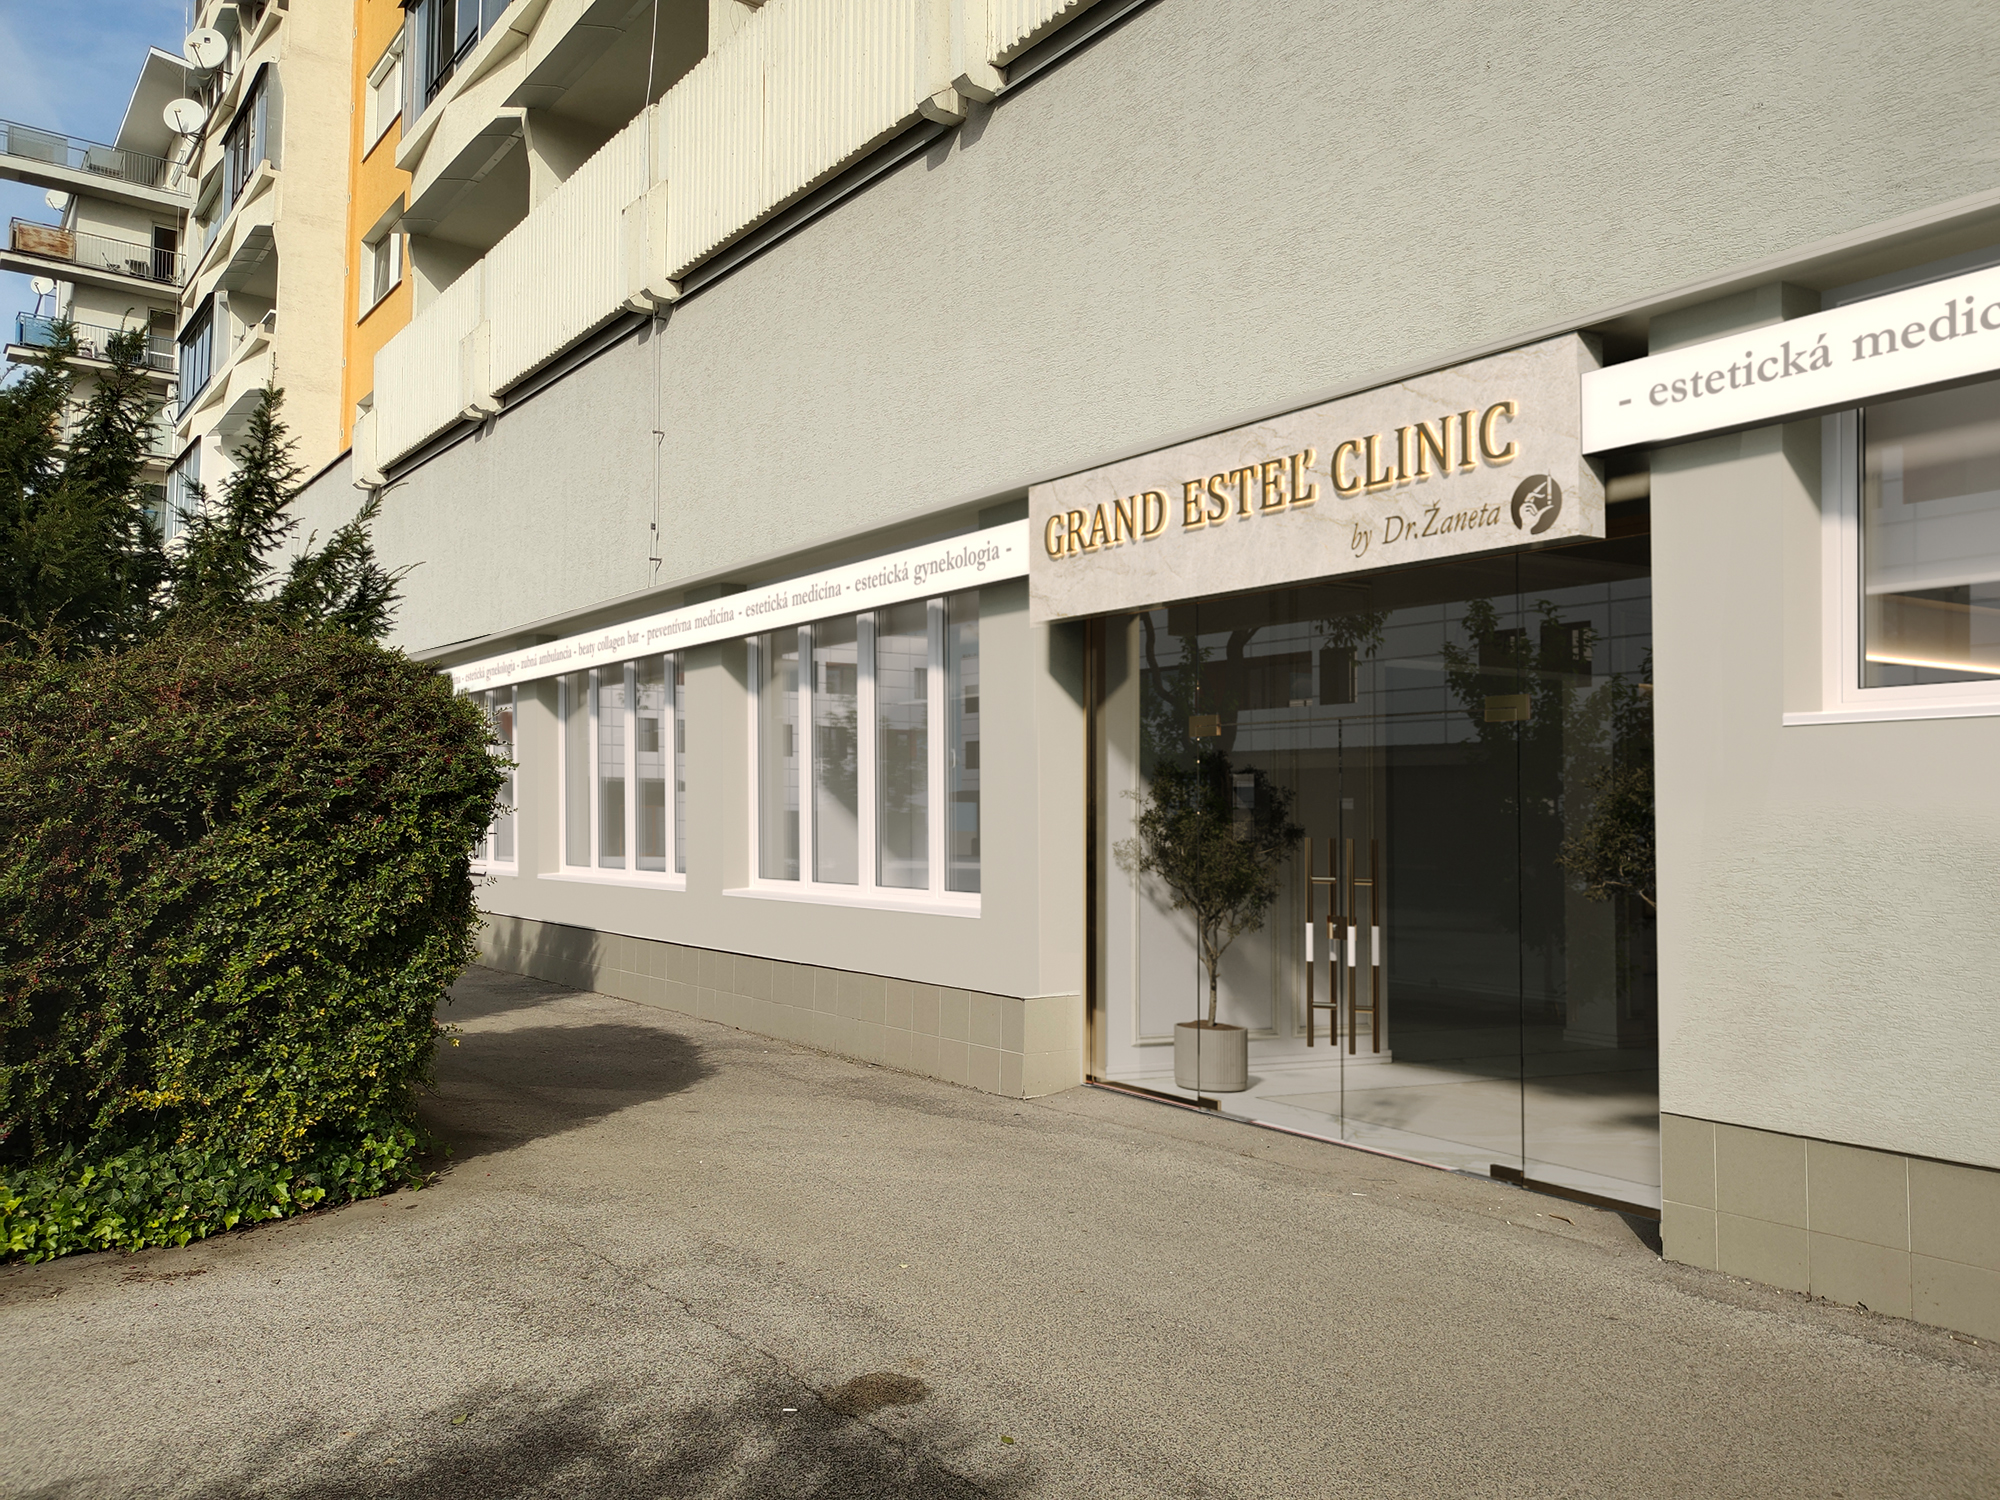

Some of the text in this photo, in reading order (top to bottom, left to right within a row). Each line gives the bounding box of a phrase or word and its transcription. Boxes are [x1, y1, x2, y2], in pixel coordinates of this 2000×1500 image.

[1649, 332, 1833, 407] estetická
[1045, 490, 1169, 557] GRAND
[1331, 401, 1518, 494] CLINIC
[1351, 523, 1372, 558] by
[539, 646, 572, 664] ambulancia
[578, 642, 596, 658] beaty
[597, 635, 625, 653] collagen
[627, 630, 640, 645] bar
[647, 618, 692, 646] preventívna
[694, 607, 735, 629] medicína
[745, 592, 788, 618] estetická
[791, 581, 842, 607] medicína
[854, 562, 909, 592] estetická
[913, 540, 1000, 585] gynekologia
